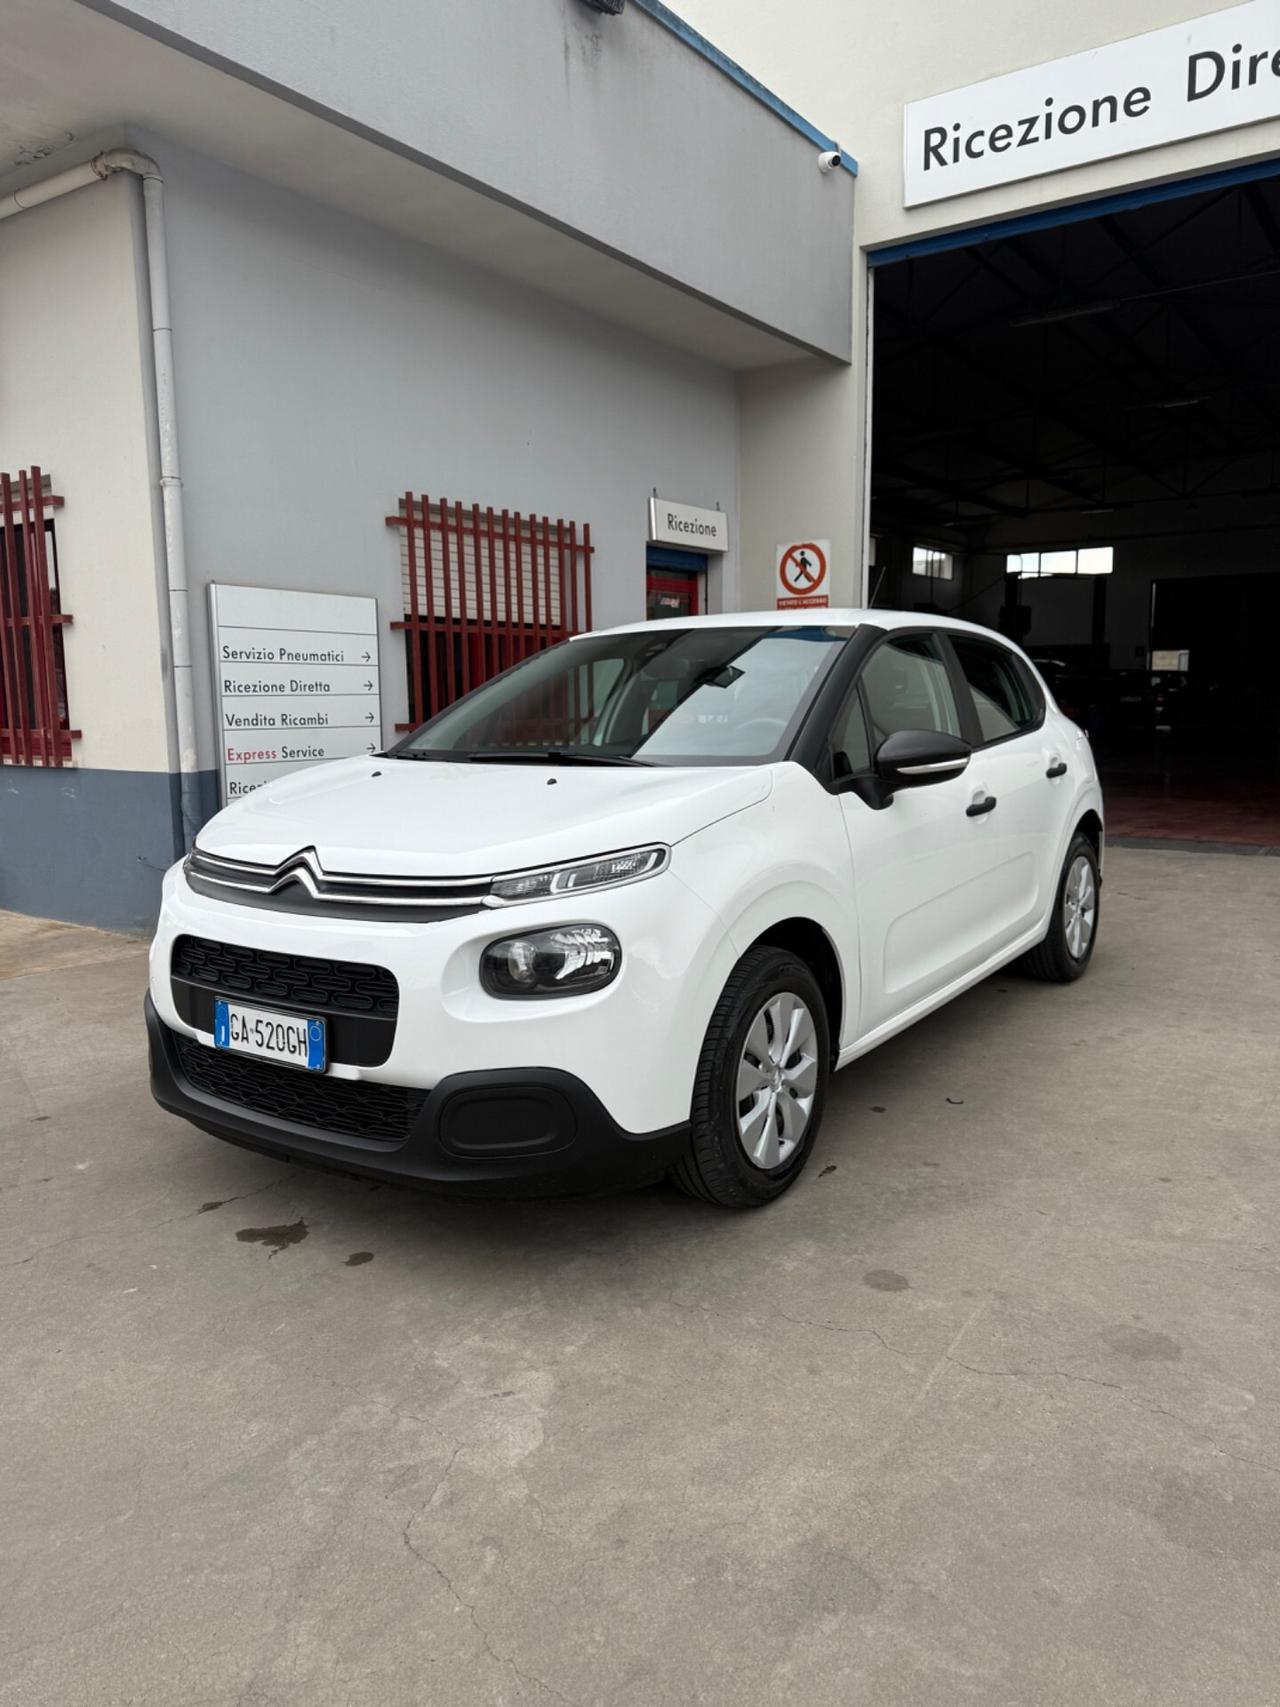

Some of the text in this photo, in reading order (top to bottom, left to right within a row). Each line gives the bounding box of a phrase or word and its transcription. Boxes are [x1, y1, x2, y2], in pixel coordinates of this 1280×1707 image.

[922, 86, 1151, 171] Ricezione
[667, 513, 717, 537] Ricezione
[222, 645, 344, 662] Servizio Pneumatici
[224, 679, 331, 693] Ricezione Diretta
[225, 712, 329, 727] Vendita Ricambi
[227, 745, 325, 763] Express Service
[229, 780, 267, 795] Rice
